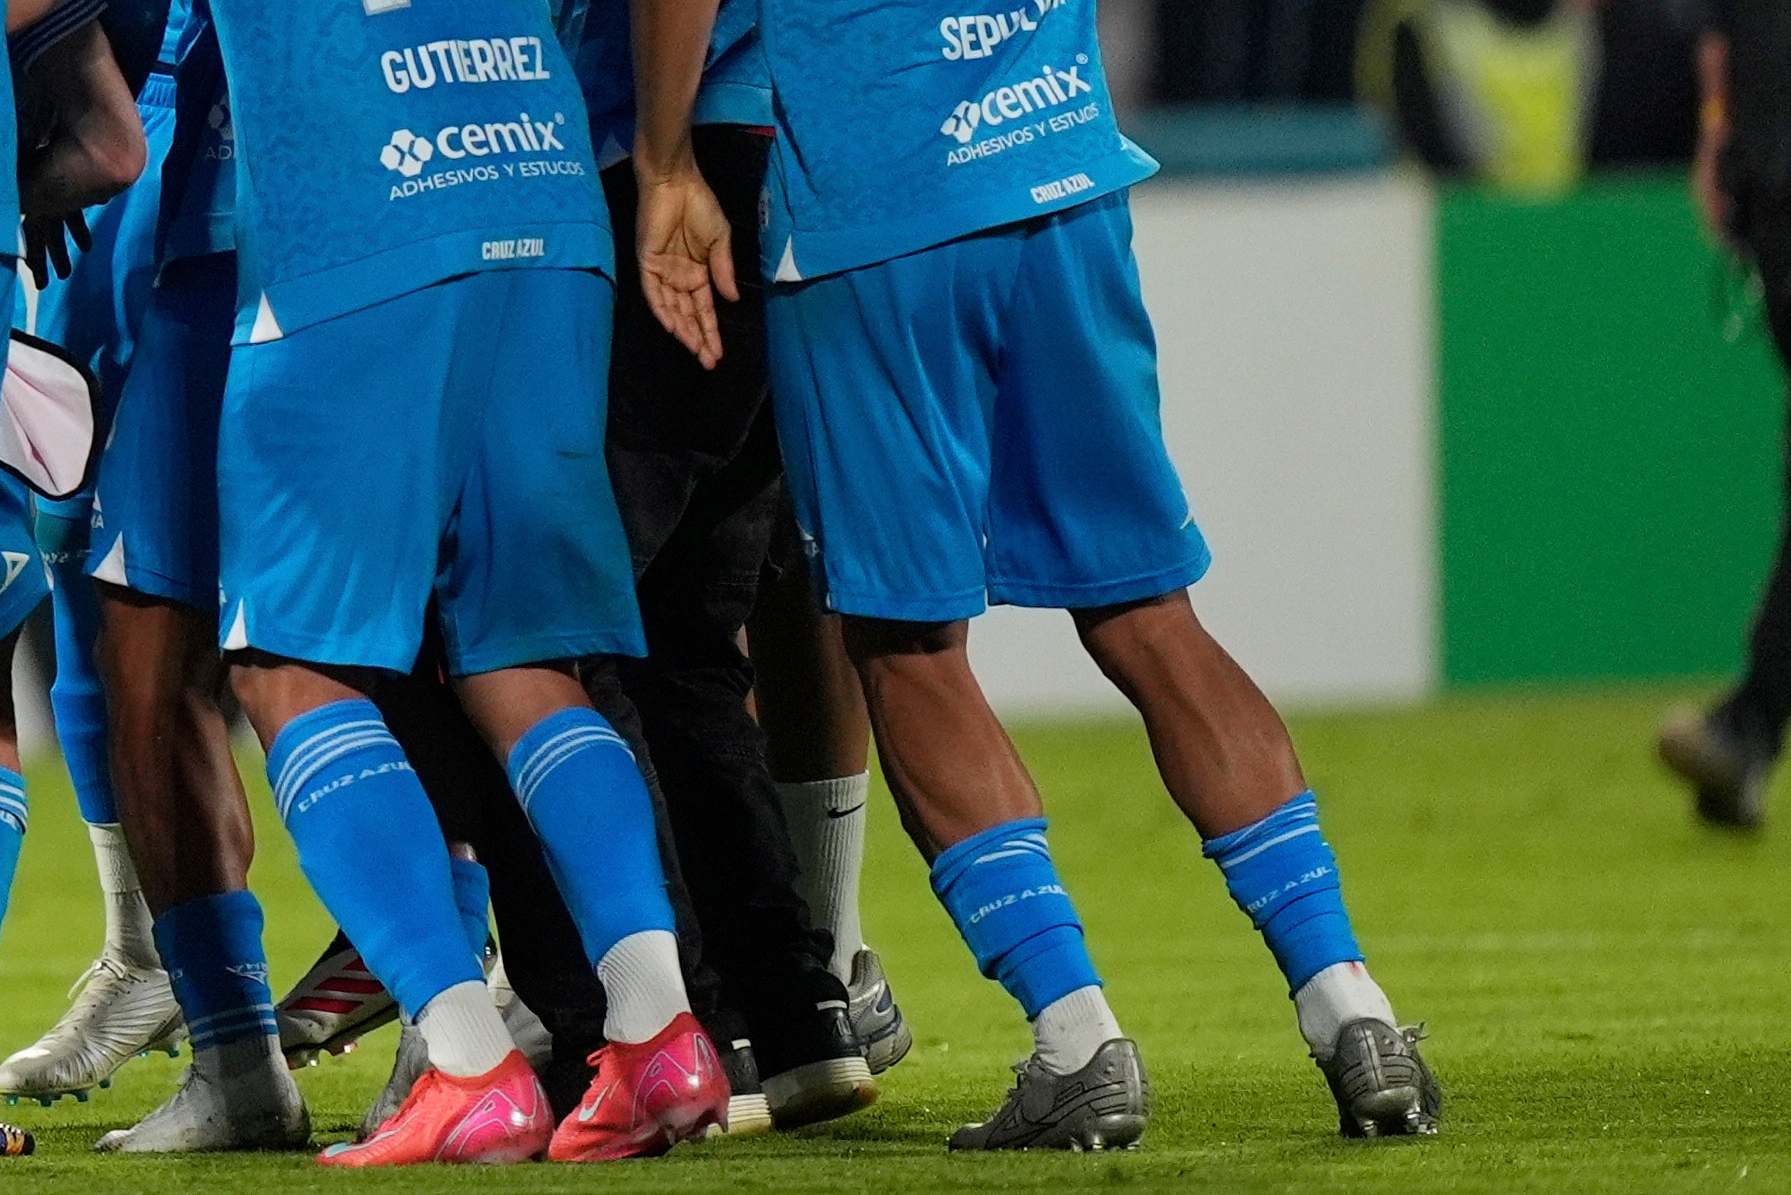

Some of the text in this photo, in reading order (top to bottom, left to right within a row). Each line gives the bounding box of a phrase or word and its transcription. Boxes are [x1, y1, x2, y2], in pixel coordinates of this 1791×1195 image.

[380, 36, 550, 94] GUTIERREZ
[981, 64, 1091, 126] cemix
[436, 112, 565, 159] cemix
[946, 128, 1035, 167] ADHESIVOS
[1034, 123, 1046, 137] Y
[389, 160, 586, 202] ADHESIVOS Y ESTUCOS
[1030, 172, 1096, 205] CRUZ AZUL
[482, 238, 545, 261] CRUZ AZUL
[297, 774, 355, 814] CRUZ
[969, 894, 1019, 924] CRUZ
[1246, 889, 1282, 914] RUZ
